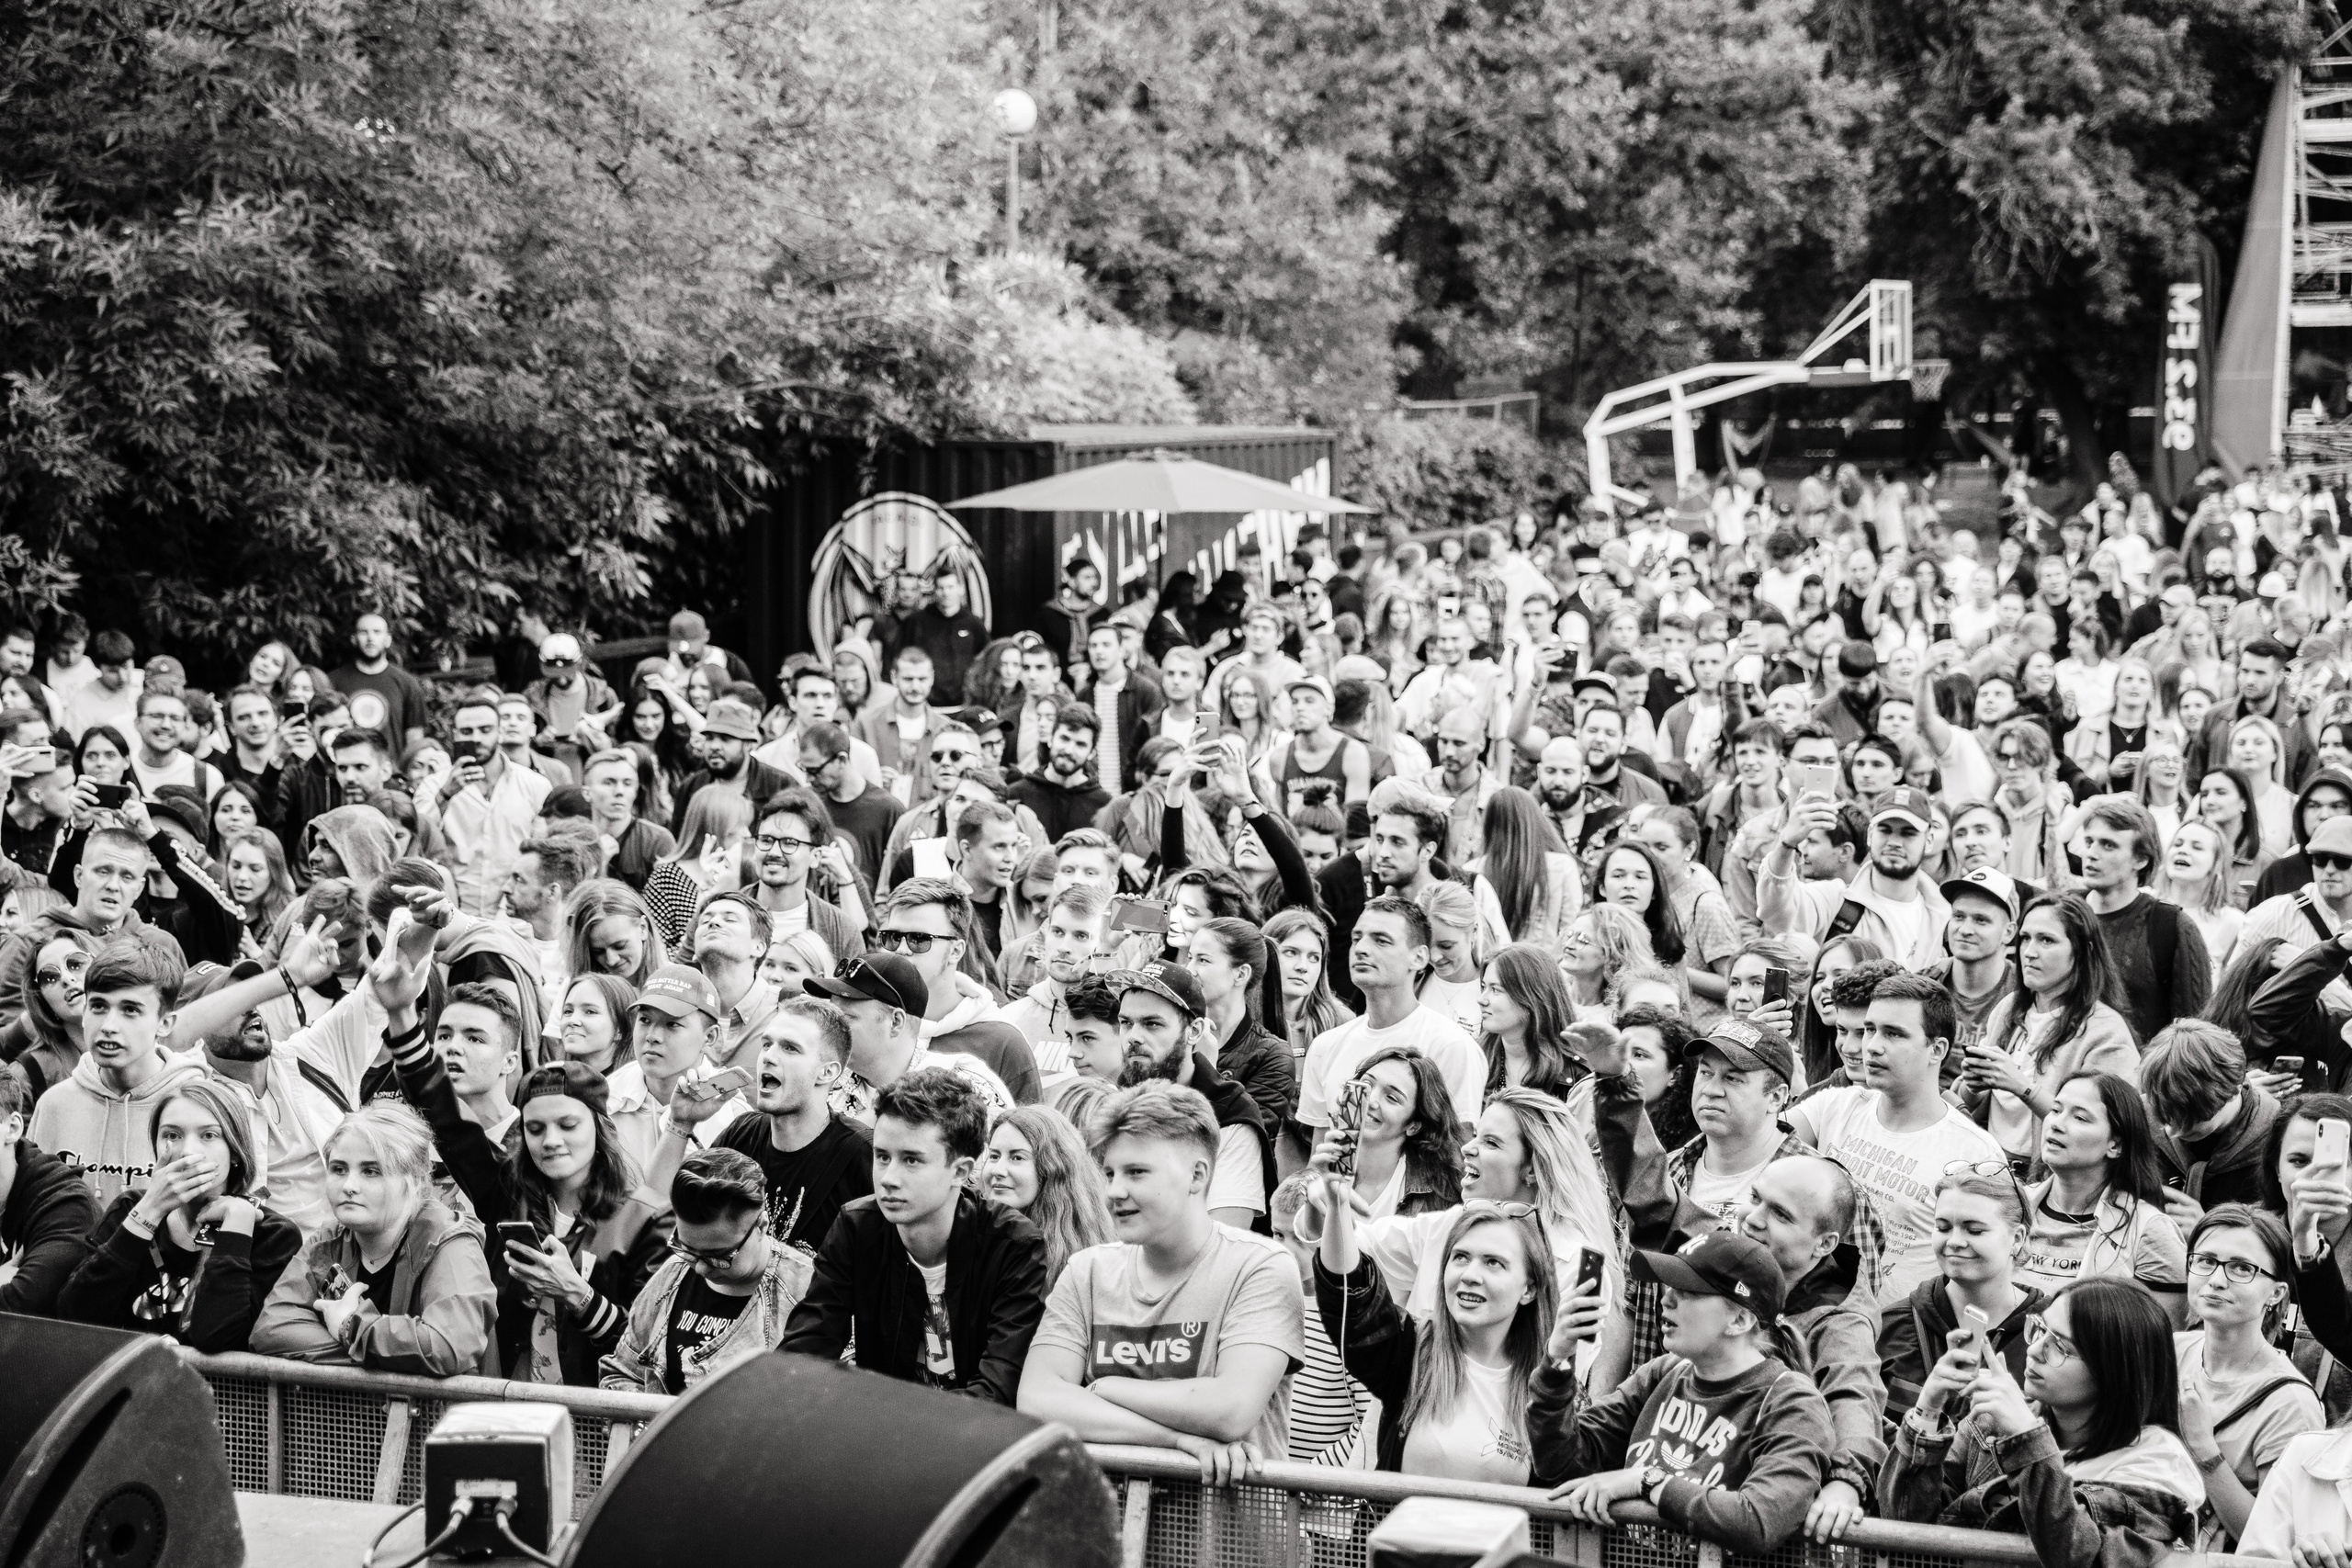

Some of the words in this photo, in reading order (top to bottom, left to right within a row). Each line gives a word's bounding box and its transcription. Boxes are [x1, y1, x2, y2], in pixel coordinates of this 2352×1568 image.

[658, 977, 680, 986] BATTLE
[679, 979, 693, 989] RAP
[663, 985, 684, 993] AGAIN
[1840, 1134, 1918, 1176] MICHIGAN
[1873, 1167, 1930, 1204] MOTOR
[1901, 1232, 1917, 1241] 1962
[676, 1310, 699, 1331] YOU
